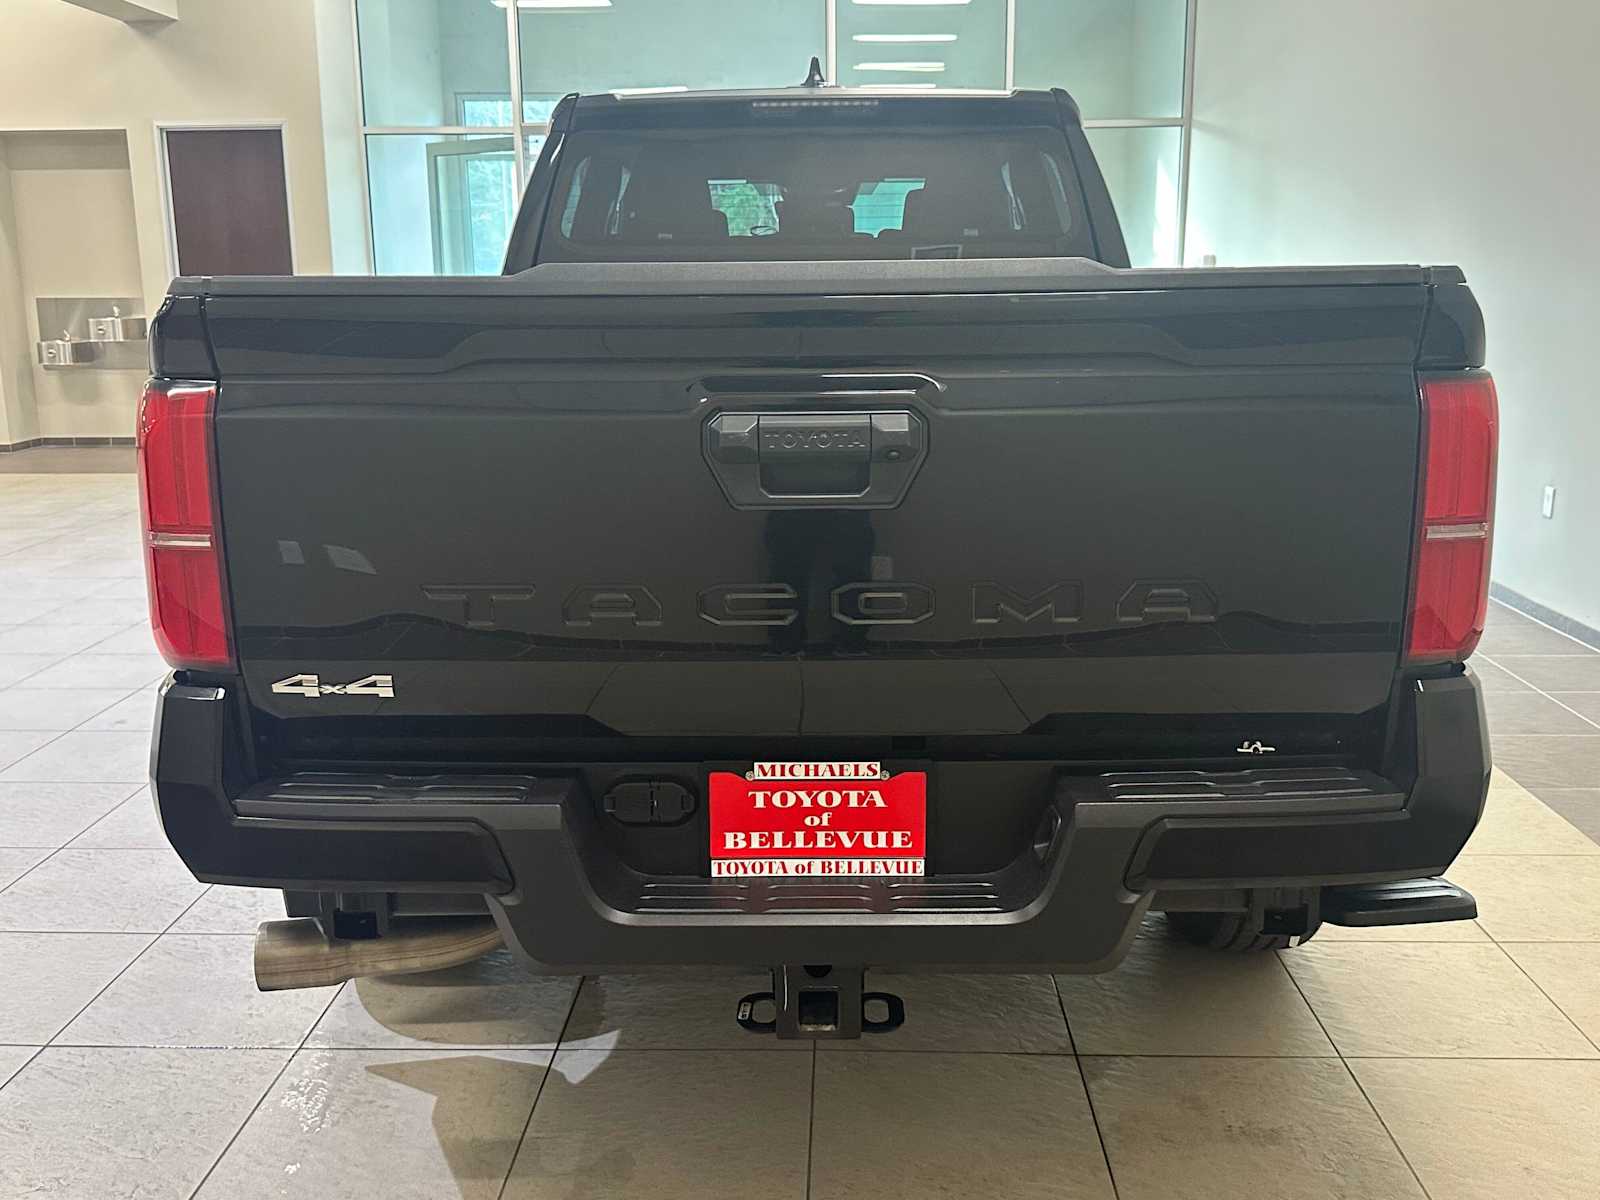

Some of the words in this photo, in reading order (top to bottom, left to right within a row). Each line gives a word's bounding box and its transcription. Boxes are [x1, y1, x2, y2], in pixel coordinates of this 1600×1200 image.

[763, 431, 867, 449] TOYOTA
[419, 581, 1218, 626] TACOMA
[271, 673, 395, 698] 4x4
[756, 763, 878, 778] MICHAELS
[748, 789, 888, 809] TOYOTA
[803, 811, 833, 827] of
[723, 830, 913, 850] BELLEVUE
[713, 860, 789, 876] TOYOTA
[794, 860, 815, 875] of
[820, 860, 924, 876] BELLEVUE
